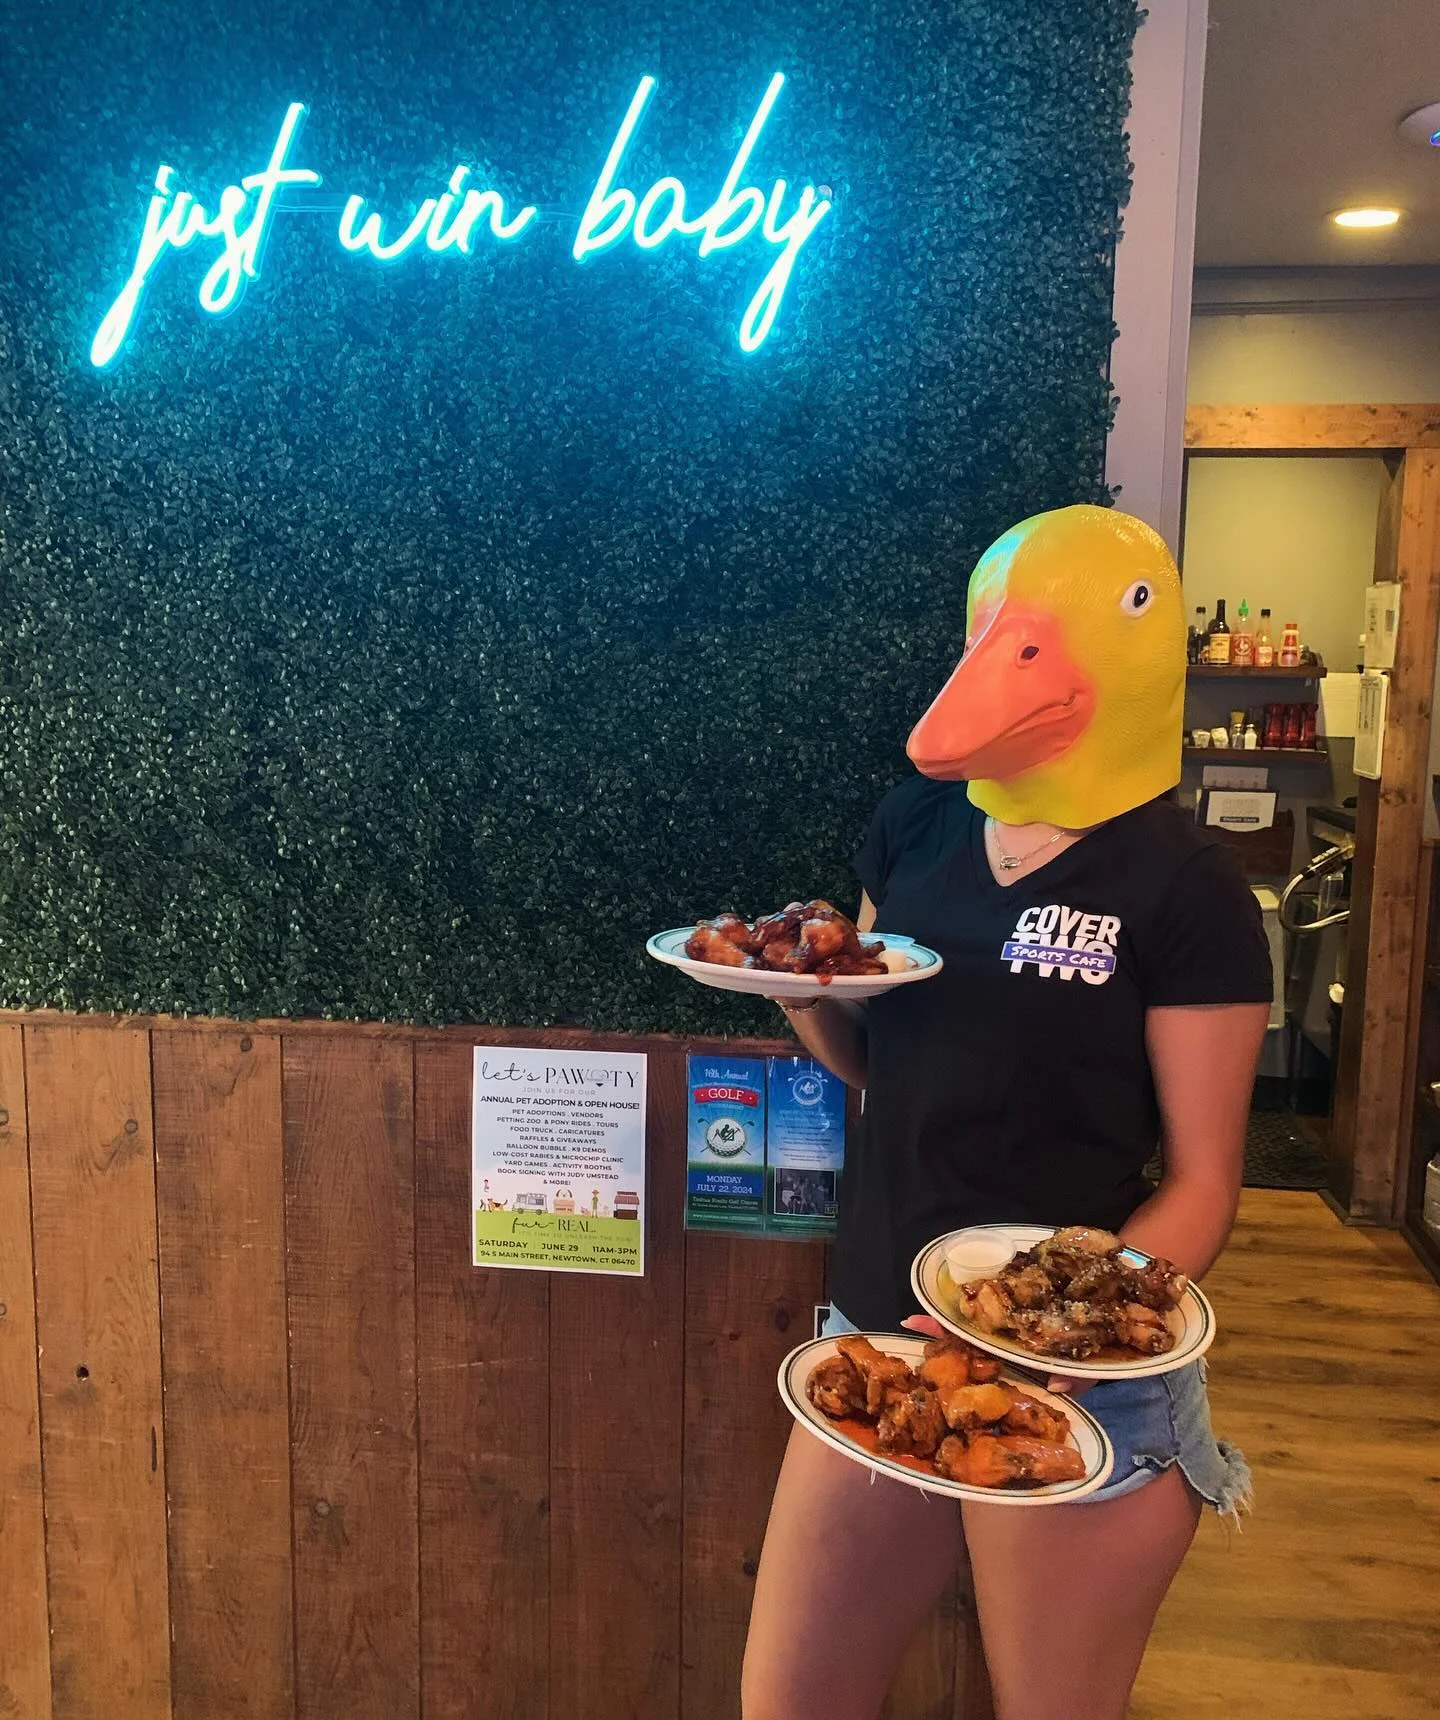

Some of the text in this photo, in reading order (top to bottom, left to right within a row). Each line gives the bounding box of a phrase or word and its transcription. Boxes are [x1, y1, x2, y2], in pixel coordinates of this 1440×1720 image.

[90, 72, 831, 367] just win baby
[1016, 905, 1121, 946] COVER
[1010, 932, 1113, 985] TWO
[1011, 946, 1106, 968] SPORTS CAFE
[482, 1061, 540, 1081] let's
[533, 1098, 576, 1106] ADOPTION
[708, 1088, 744, 1100] GOLF
[479, 1239, 528, 1248] SATURDAY
[541, 1243, 565, 1251] JUNE
[593, 1246, 637, 1255] 11AM-3PM
[553, 1255, 598, 1264] NEWTOWN,
